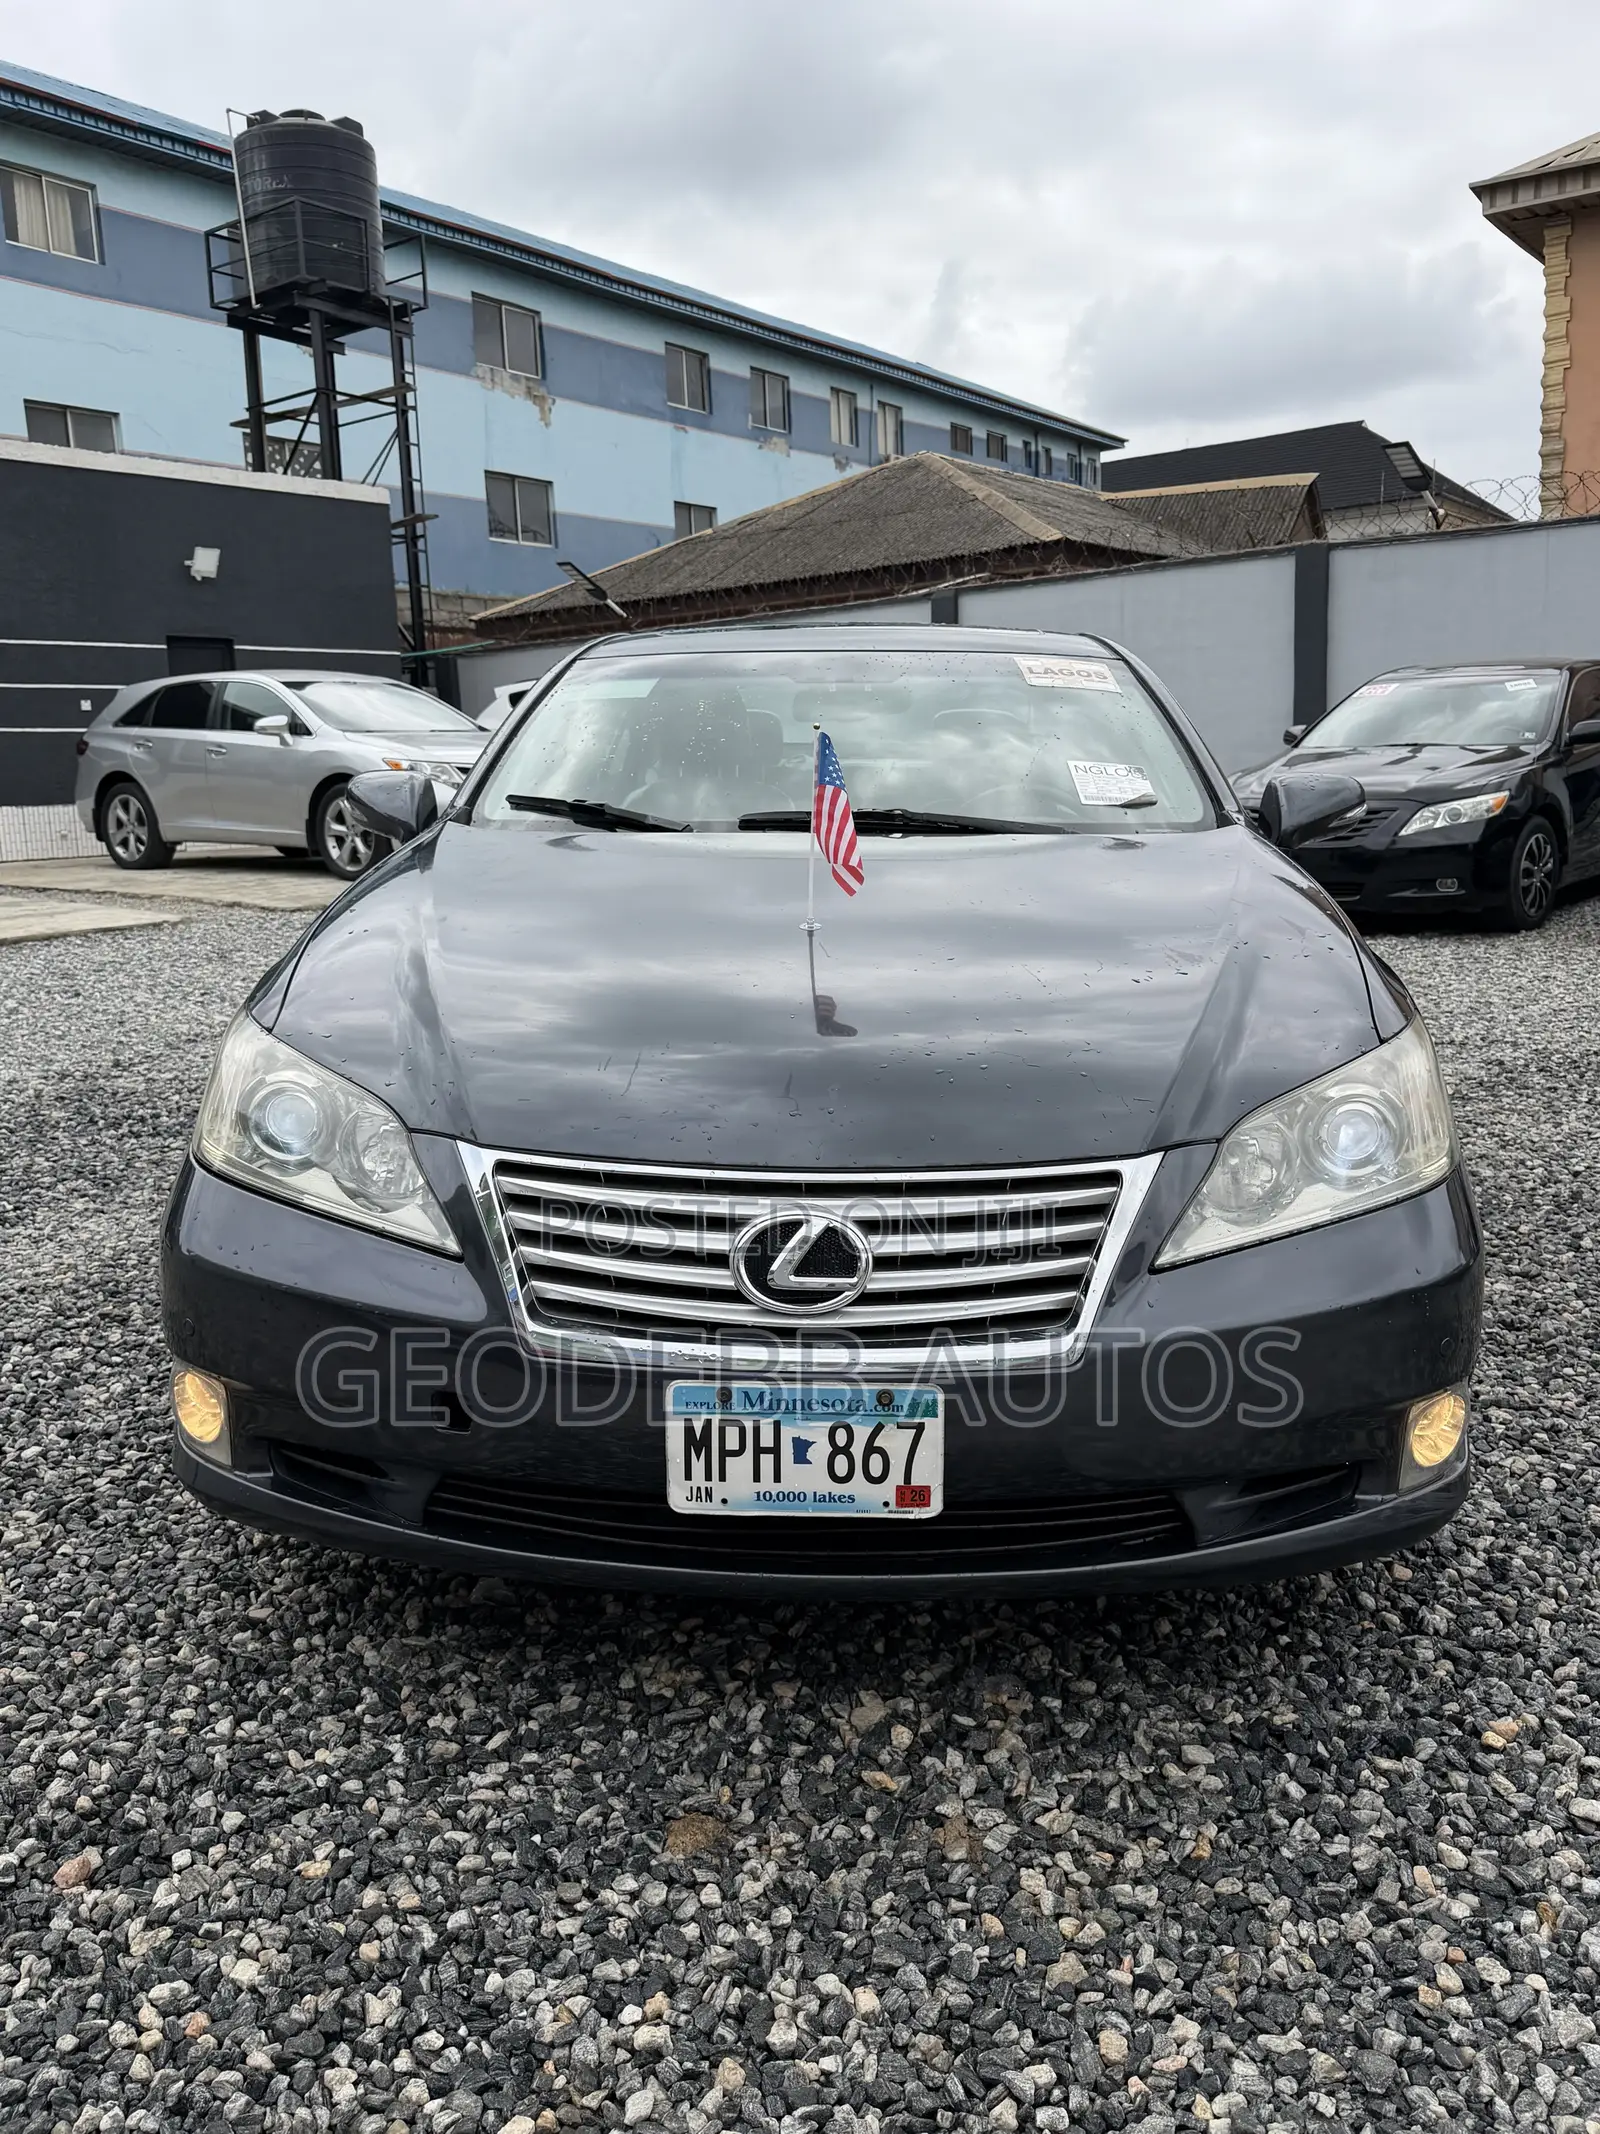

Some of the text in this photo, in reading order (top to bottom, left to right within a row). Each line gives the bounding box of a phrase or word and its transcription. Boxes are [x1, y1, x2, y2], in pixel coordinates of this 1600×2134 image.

[1027, 667, 1109, 680] LAGOS
[684, 1400, 736, 1411] EXPLORE
[683, 1418, 926, 1486] MPH 867
[685, 1486, 713, 1504] JAN
[753, 1490, 856, 1505] 10,000 lakes
[910, 1489, 926, 1503] 26
